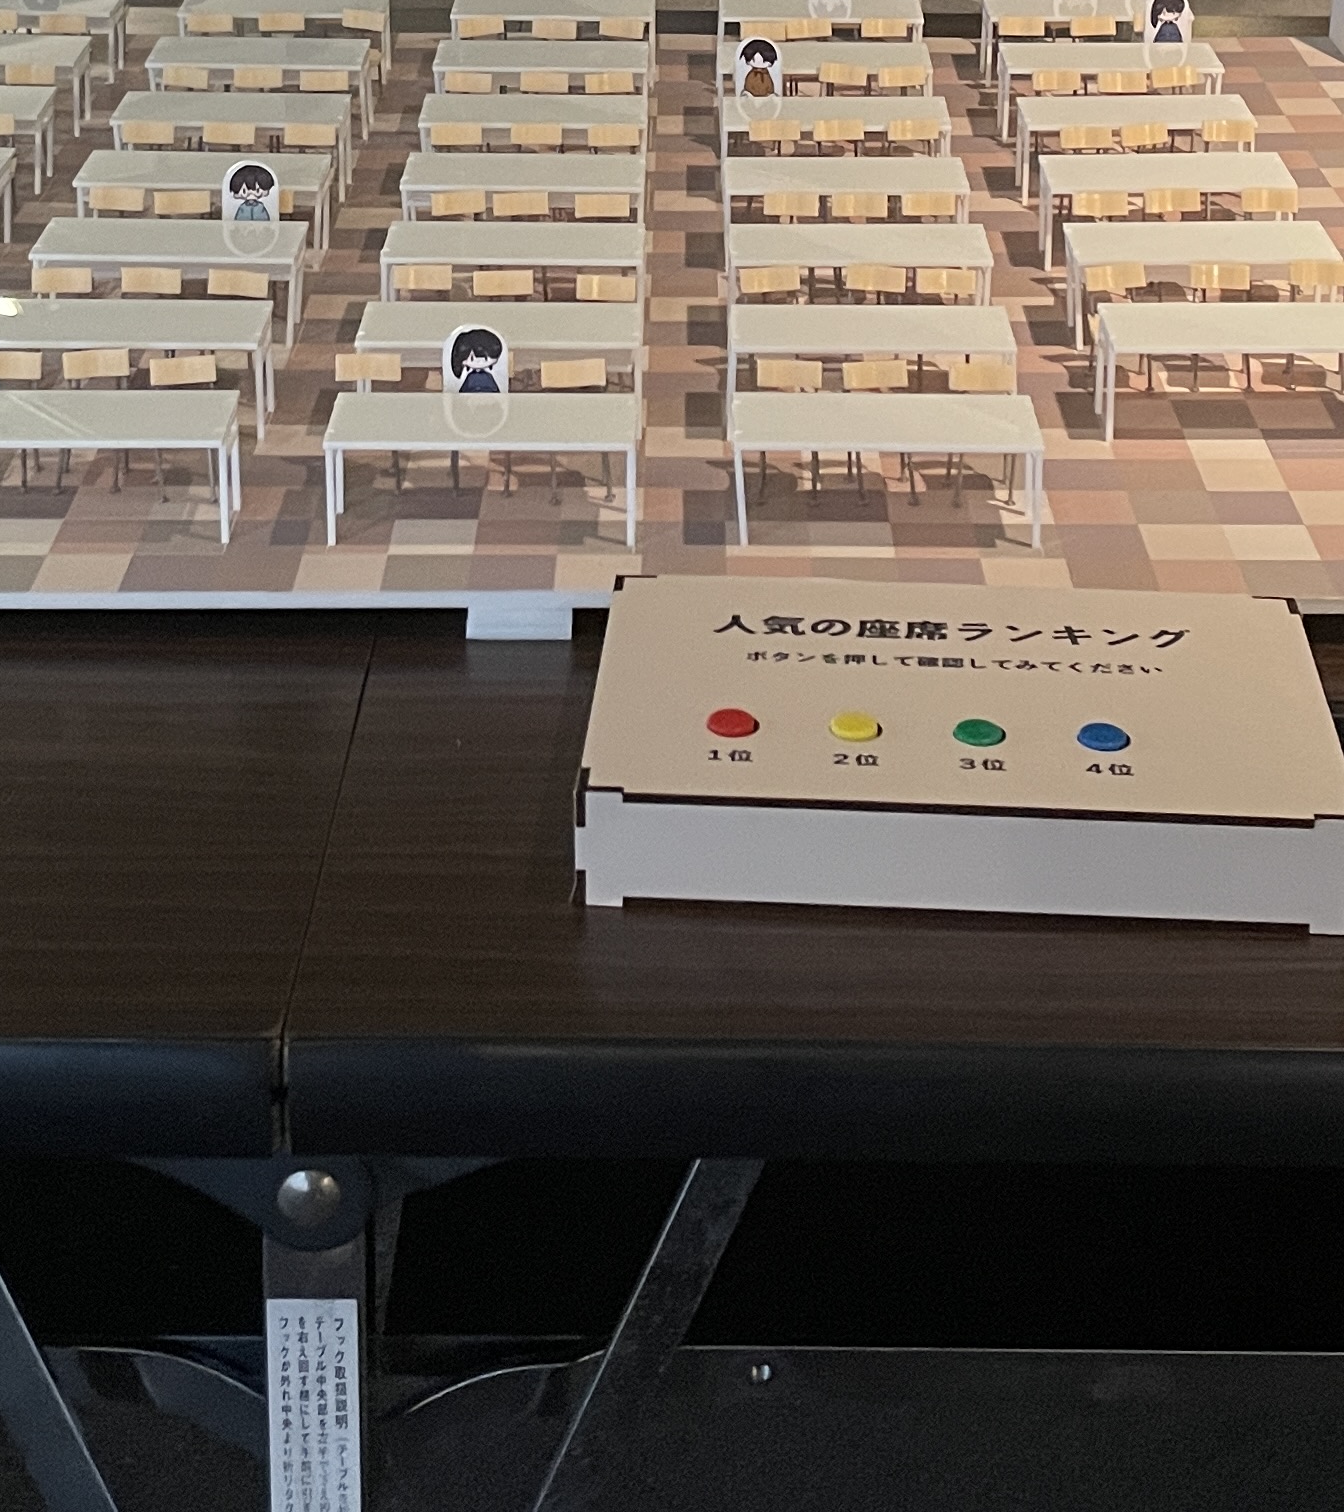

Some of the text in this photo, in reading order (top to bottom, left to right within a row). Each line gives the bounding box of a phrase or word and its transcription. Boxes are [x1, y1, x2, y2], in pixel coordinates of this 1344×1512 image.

[713, 614, 1190, 648] 人気の座席ランキング
[746, 650, 1164, 675] ボタンを押して確認してみてください
[707, 749, 753, 763] 1位
[832, 753, 879, 766] 2位
[959, 758, 1007, 771] 3位
[1085, 763, 1135, 777] 4位
